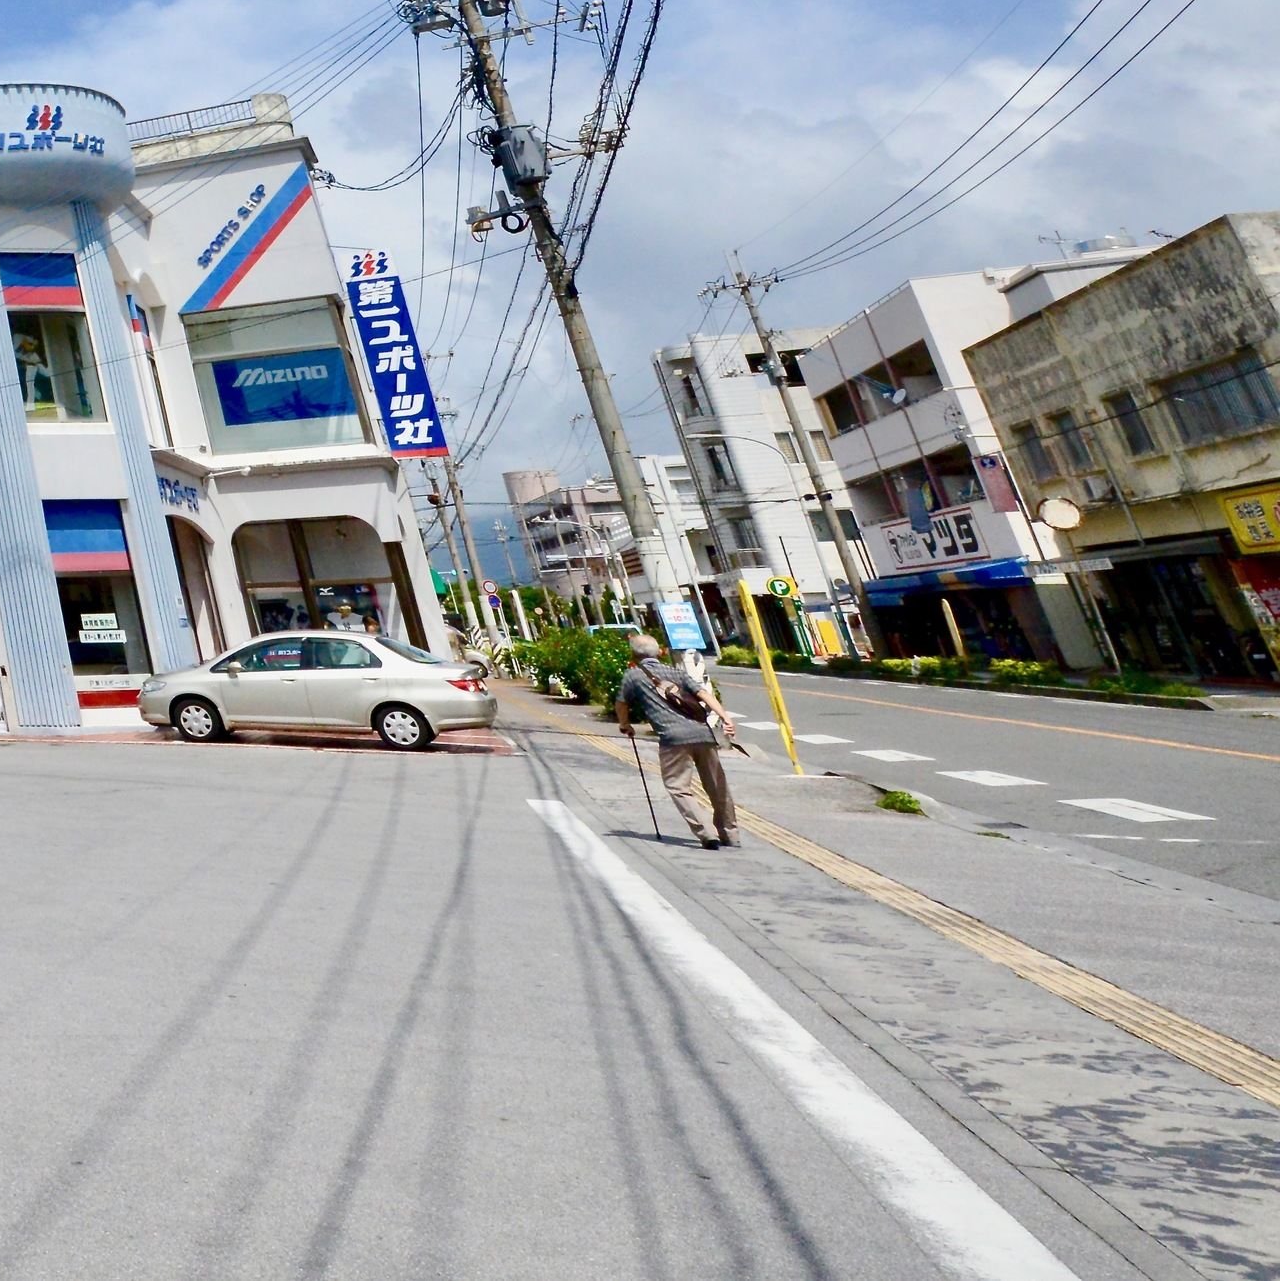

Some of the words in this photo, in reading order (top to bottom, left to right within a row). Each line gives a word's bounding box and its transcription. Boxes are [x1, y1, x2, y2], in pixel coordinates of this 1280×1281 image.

[197, 219, 240, 269] SPORTS
[237, 184, 266, 220] SHOP
[773, 580, 788, 595] P
